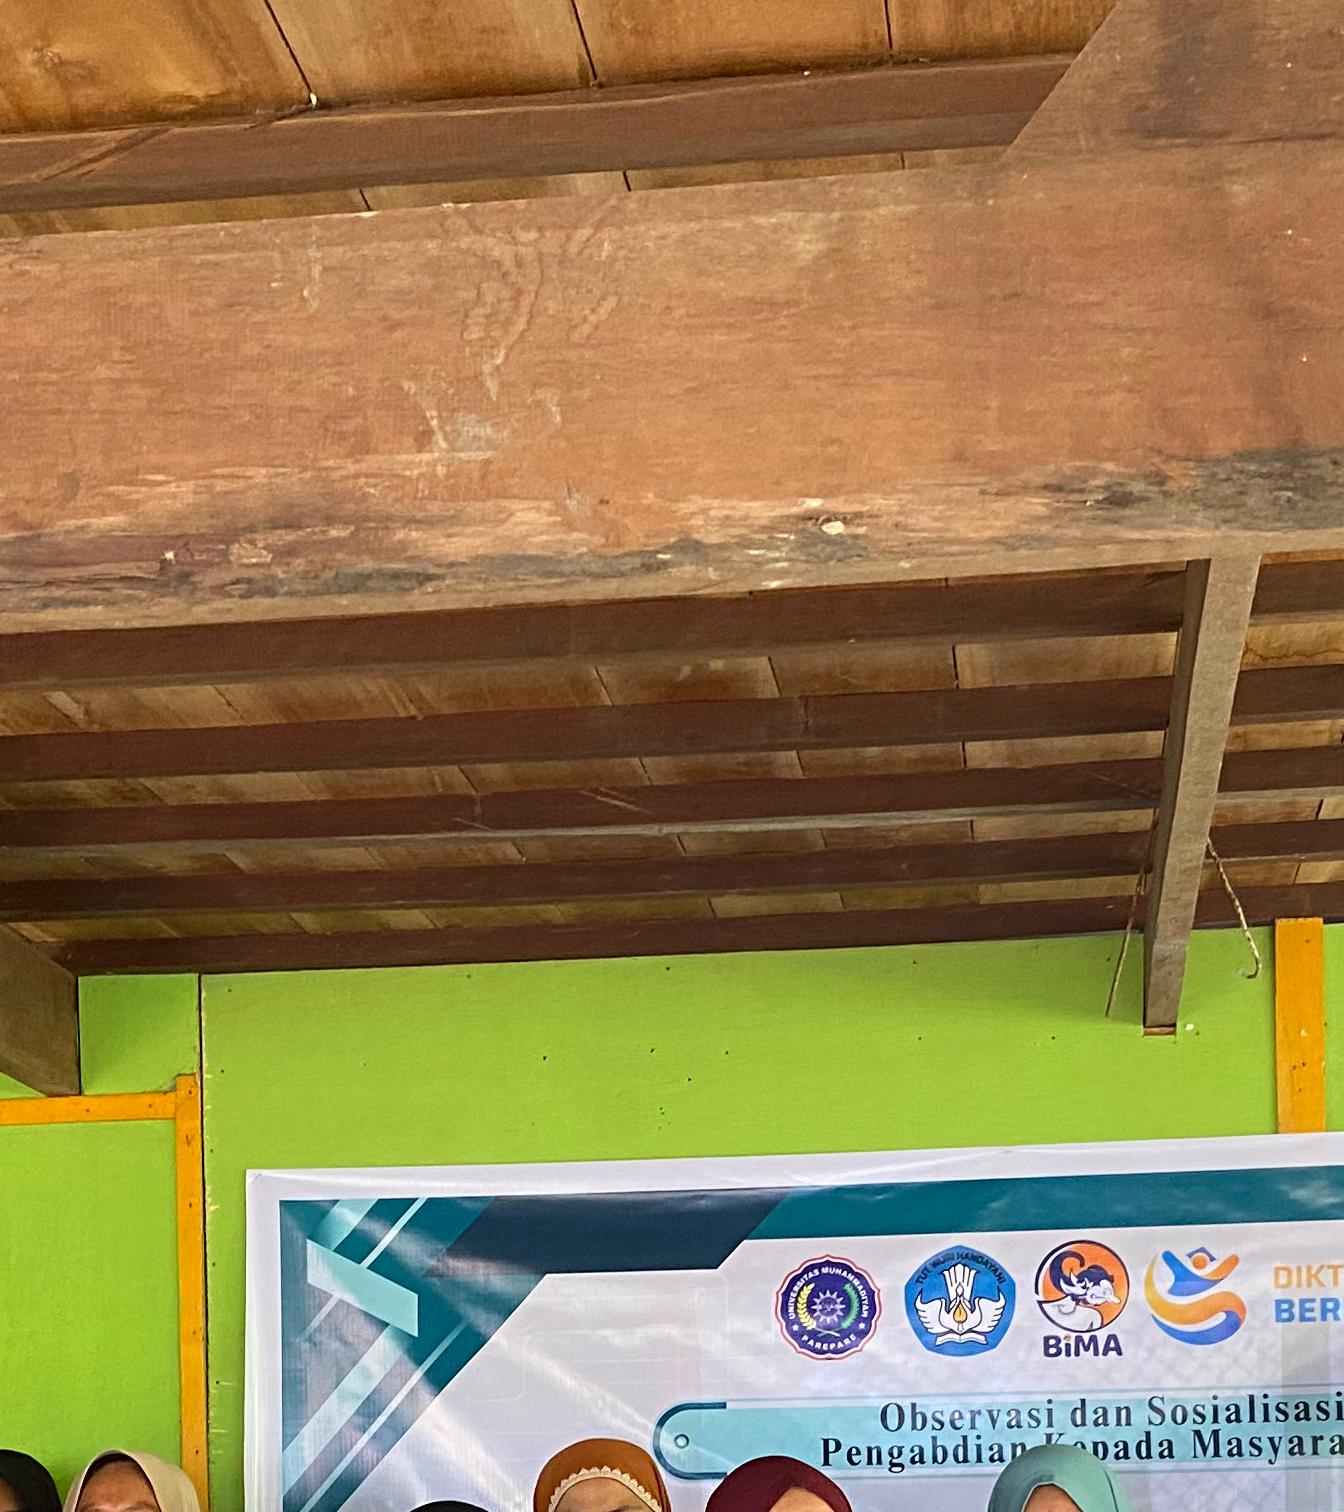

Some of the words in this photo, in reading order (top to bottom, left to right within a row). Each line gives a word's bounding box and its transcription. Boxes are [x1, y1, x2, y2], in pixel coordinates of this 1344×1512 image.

[787, 1268, 820, 1320] UNIVERSITAS
[821, 1266, 870, 1318] MUHAMMADIYAH
[801, 1333, 857, 1350] PAREPARE
[1043, 1333, 1123, 1358] BiMA
[880, 1398, 1055, 1432] Observasi
[1070, 1398, 1132, 1428] dan
[821, 1434, 1026, 1474] Pengabdian
